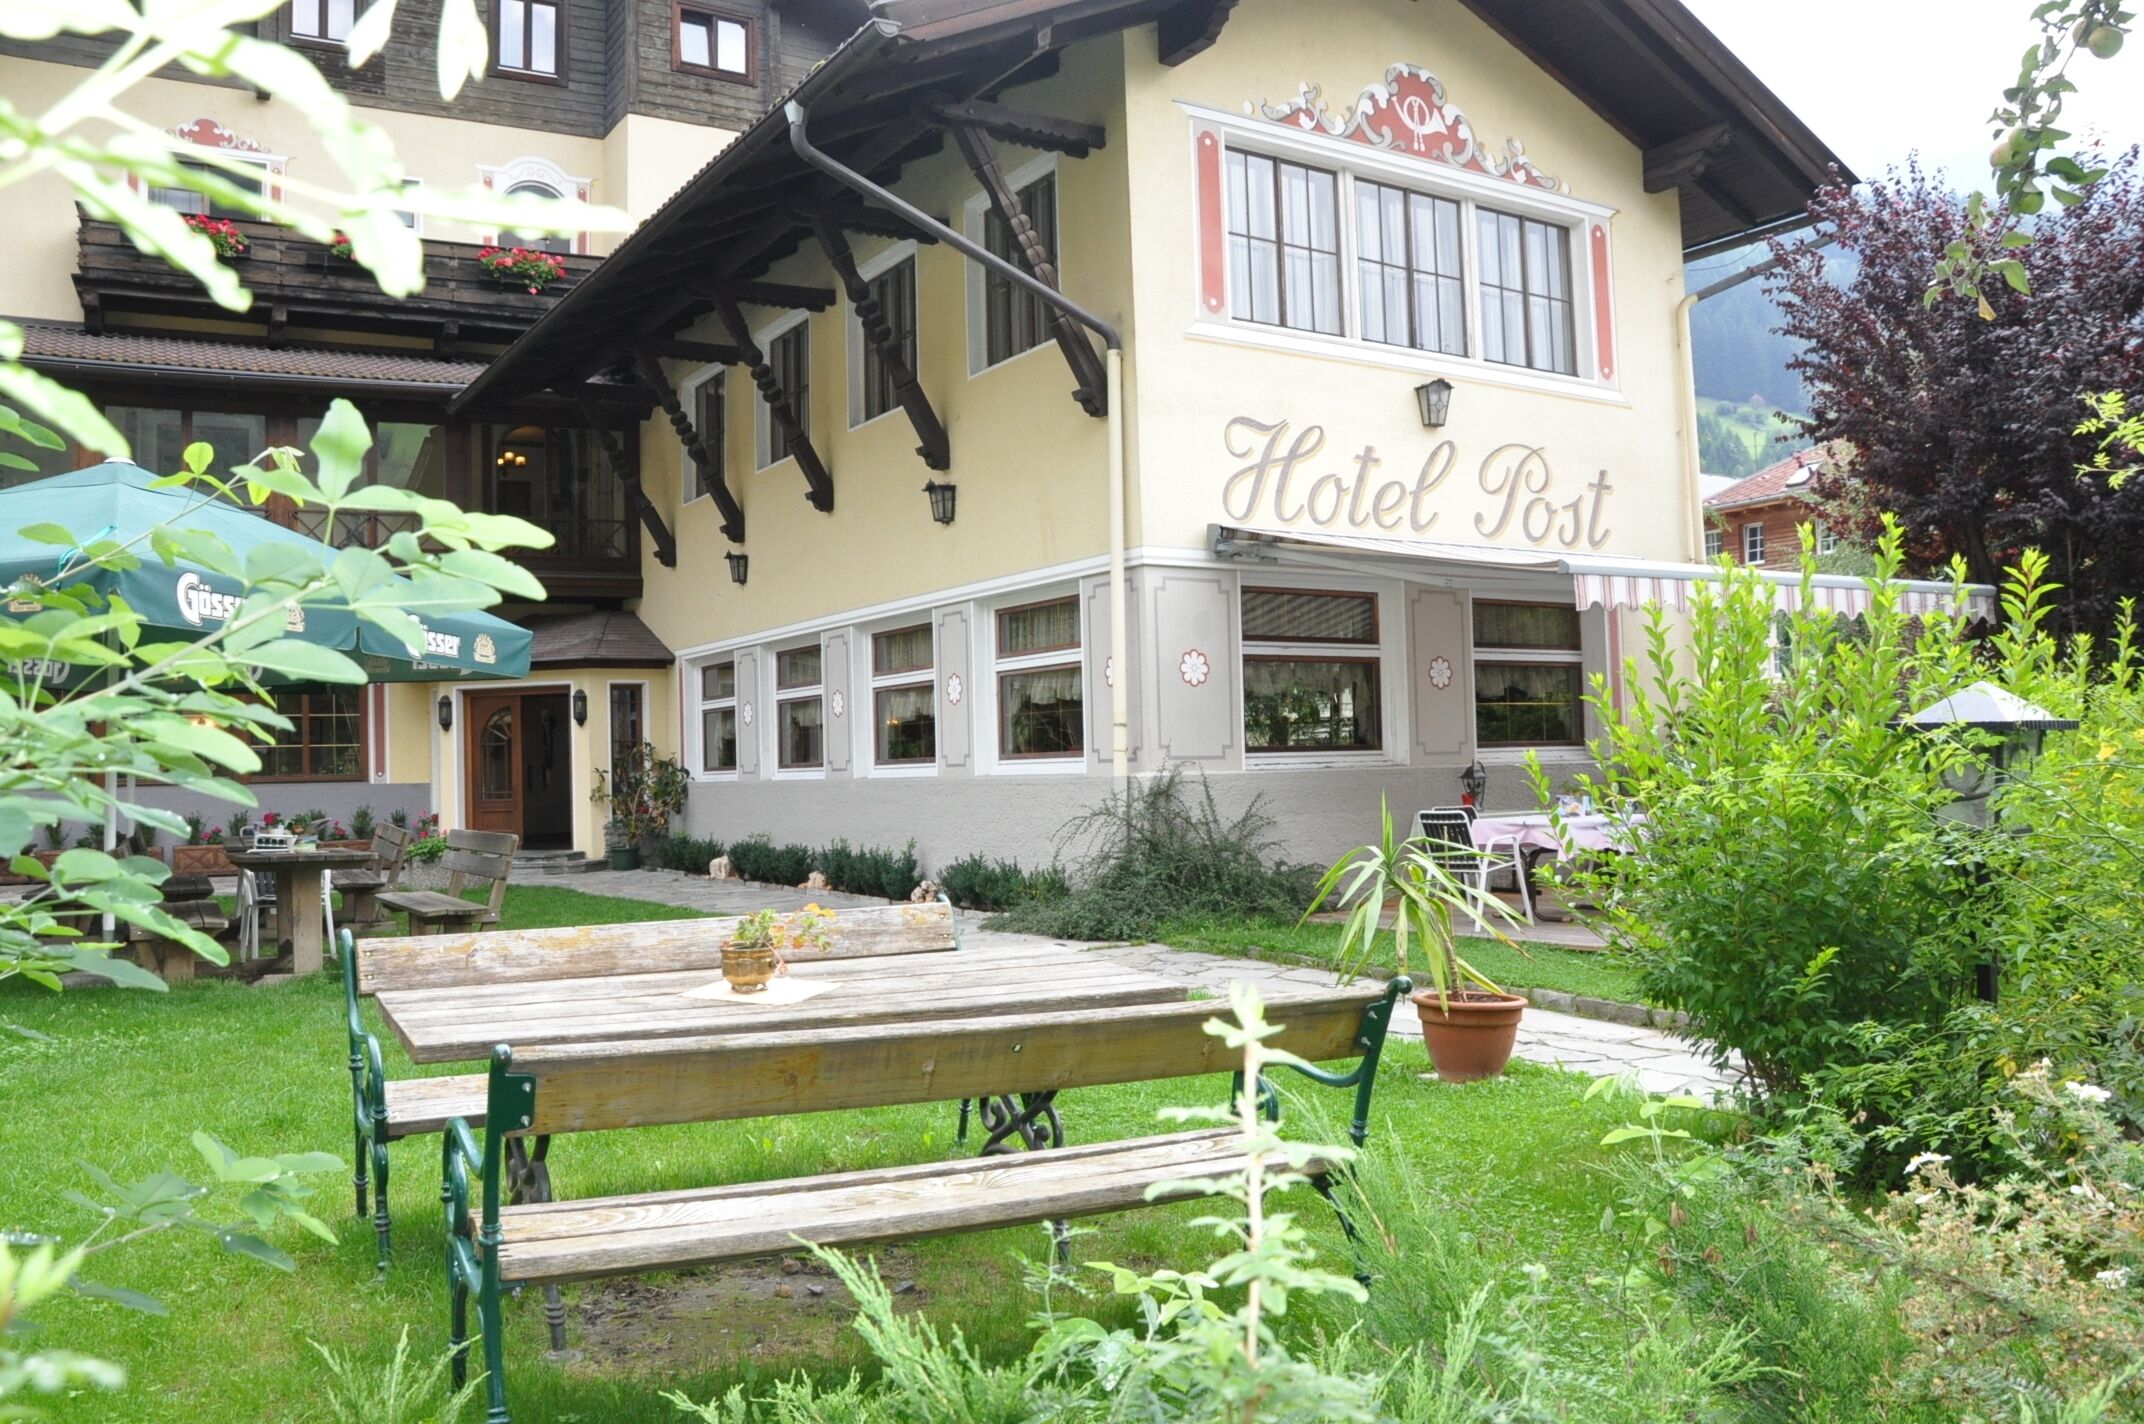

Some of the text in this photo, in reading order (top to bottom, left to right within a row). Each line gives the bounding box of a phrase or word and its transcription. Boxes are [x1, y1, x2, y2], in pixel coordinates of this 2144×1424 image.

[1222, 415, 1614, 548] Hotel Post
[176, 572, 246, 626] Göss
[405, 614, 461, 659] sser
